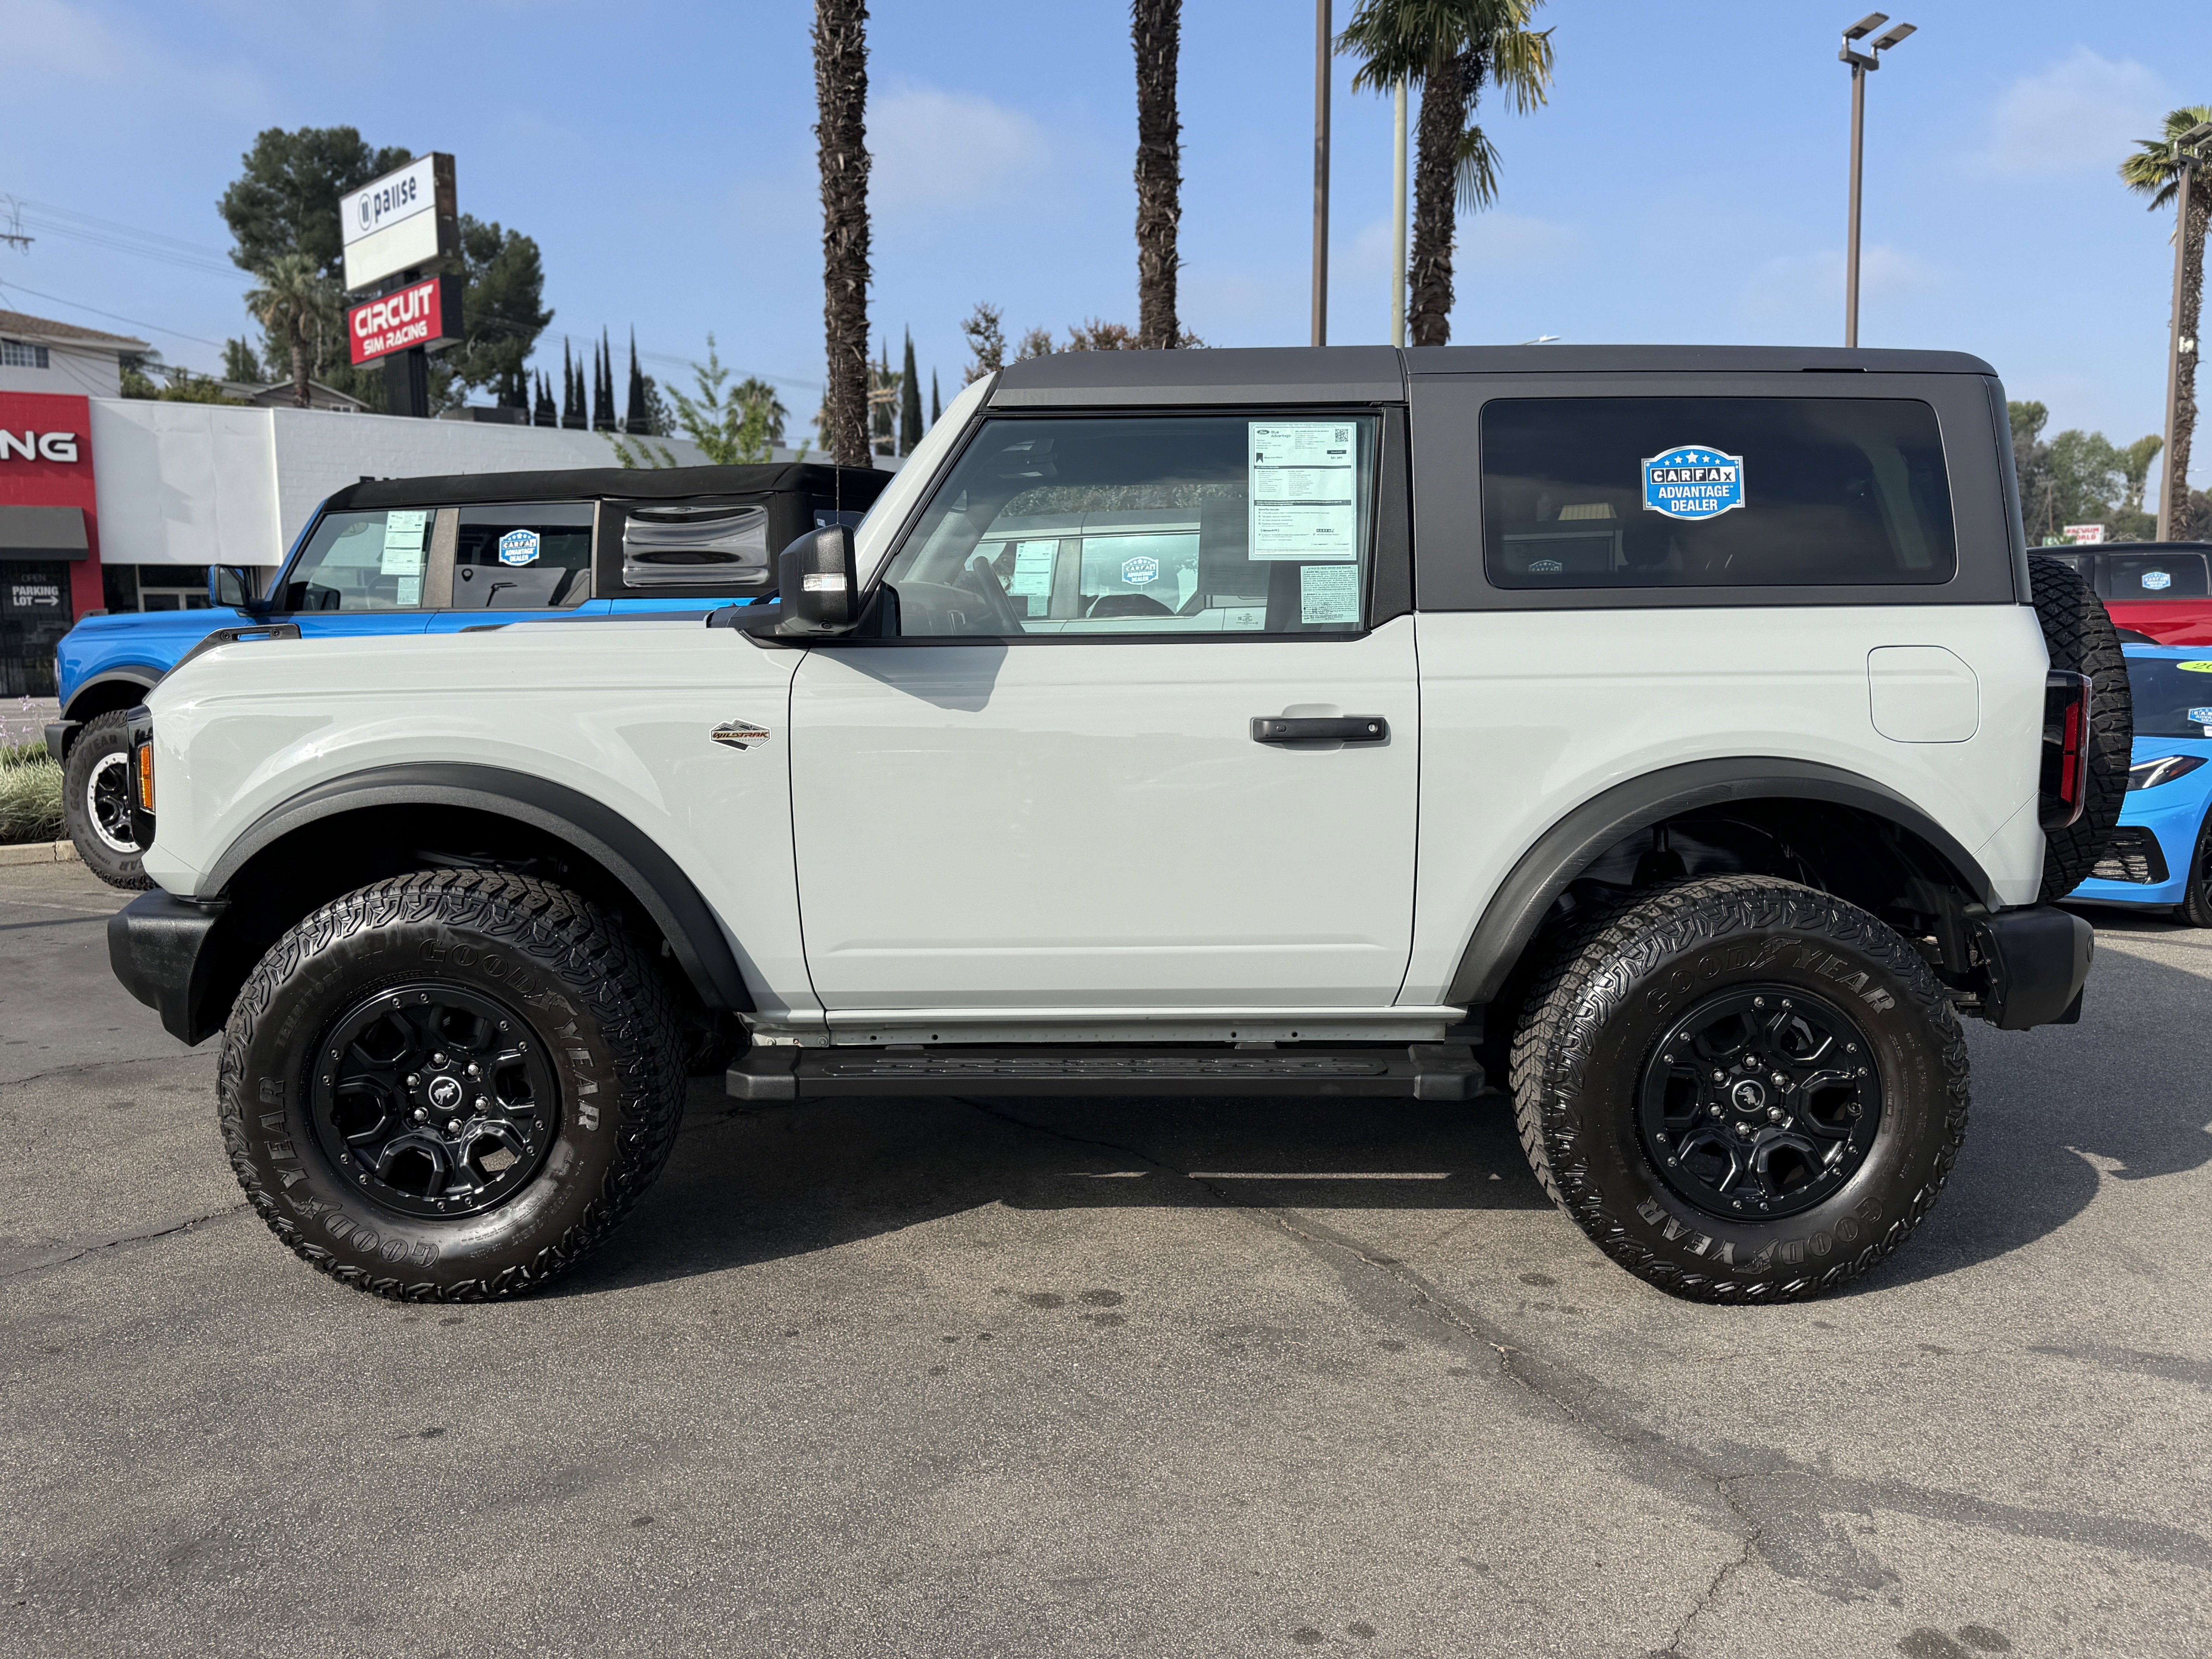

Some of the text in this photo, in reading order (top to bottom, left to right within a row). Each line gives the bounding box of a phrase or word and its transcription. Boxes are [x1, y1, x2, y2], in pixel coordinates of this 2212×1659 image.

[374, 176, 417, 223] pause
[354, 284, 434, 338] CIRCUIT
[363, 320, 427, 356] SIM RACING
[1653, 469, 1733, 482] CARFAX
[1671, 499, 1718, 512] DEALER
[503, 540, 535, 548] CARFAX
[12, 586, 59, 596] PARKING
[13, 596, 33, 606] LOT
